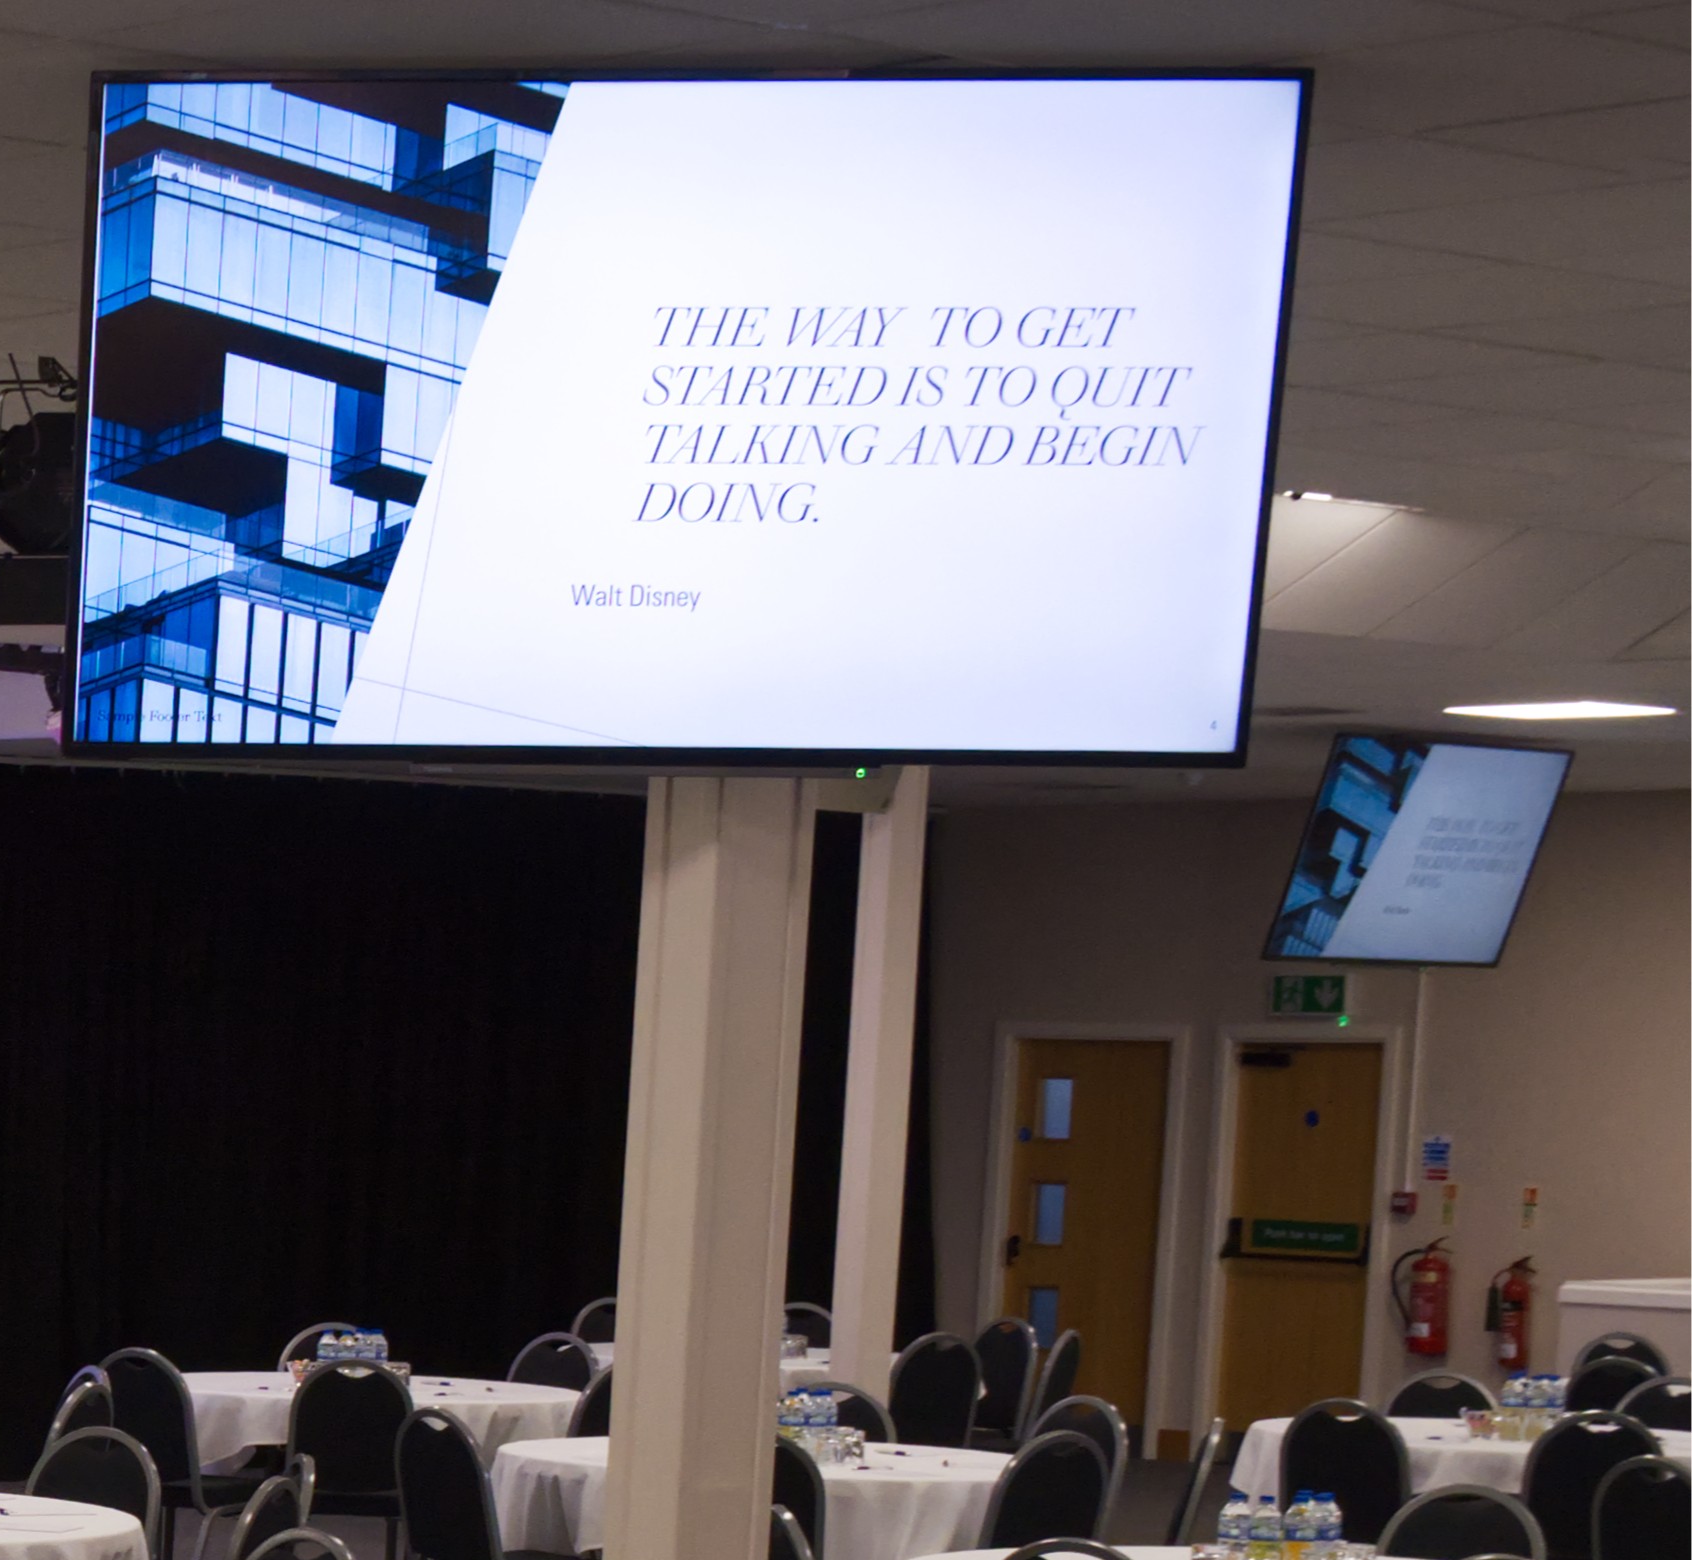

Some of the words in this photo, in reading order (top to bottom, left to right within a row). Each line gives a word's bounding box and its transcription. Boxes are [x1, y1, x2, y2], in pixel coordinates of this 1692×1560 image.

[652, 306, 770, 348] THE
[784, 306, 907, 349] WAY
[928, 306, 1004, 349] TO
[1016, 306, 1136, 349] GET
[642, 365, 888, 407] STARTED
[894, 366, 949, 407] IS
[962, 366, 1036, 407] TO
[1050, 366, 1194, 420] QUIT
[643, 424, 879, 466] TALKING
[885, 424, 1015, 466] AND
[1023, 424, 1208, 467] BEGIN
[632, 482, 820, 524] DOING.
[571, 584, 623, 609] Walt
[629, 584, 702, 613] Disney
